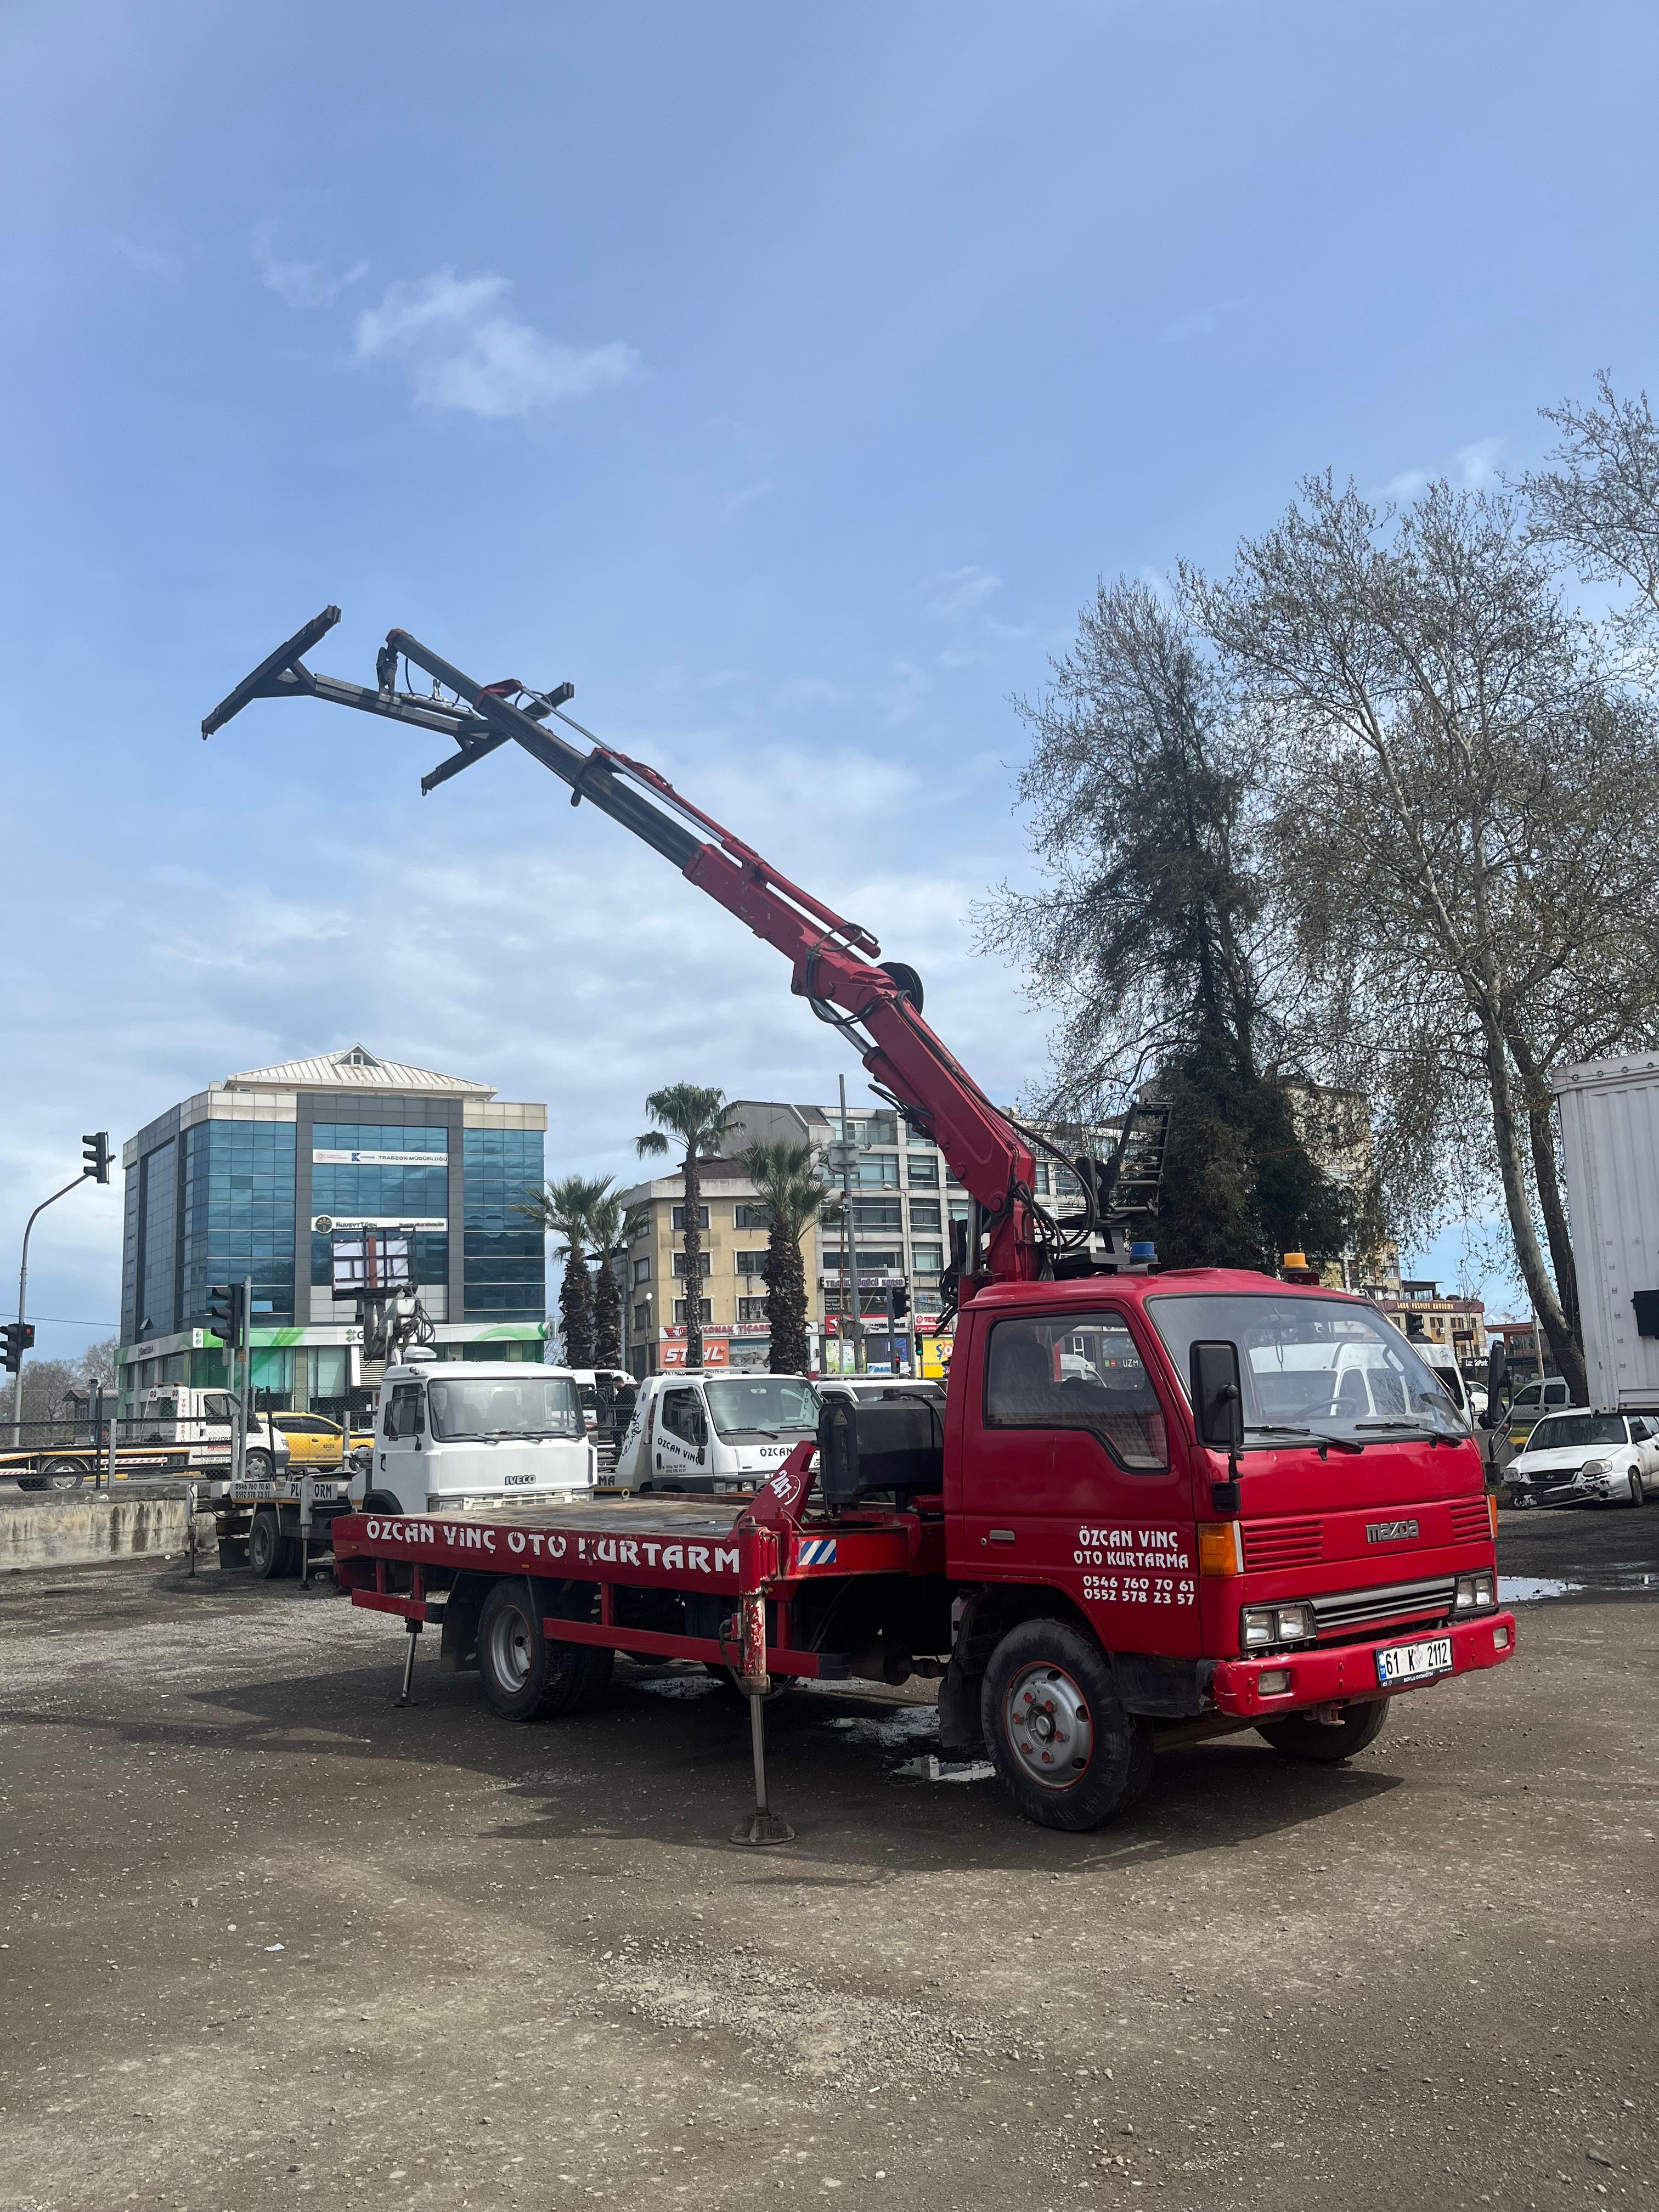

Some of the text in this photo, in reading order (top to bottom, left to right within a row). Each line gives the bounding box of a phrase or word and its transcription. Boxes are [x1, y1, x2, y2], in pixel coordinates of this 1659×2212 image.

[702, 1324, 770, 1333] KONAK TİCARE
[665, 1346, 724, 1362] STHL
[936, 1344, 953, 1361] ŞO
[658, 1436, 680, 1455] ÖZCAN
[760, 1446, 792, 1457] ÖZCAN
[505, 1475, 536, 1485] IVECO
[291, 1483, 332, 1498] PLORM
[366, 1516, 434, 1544] ÖZCAN
[507, 1532, 567, 1558] OTO
[579, 1537, 739, 1573] KURTARM
[1079, 1526, 1132, 1548] ÖZCAN
[1074, 1550, 1188, 1569] OTO KURTARMA
[1083, 1576, 1194, 1592] 0546 760 70 61
[1084, 1588, 1194, 1605] 0552 578 23 57
[1386, 1651, 1399, 1675] 61
[1408, 1649, 1415, 1672] K
[1427, 1642, 1447, 1667] 2112
